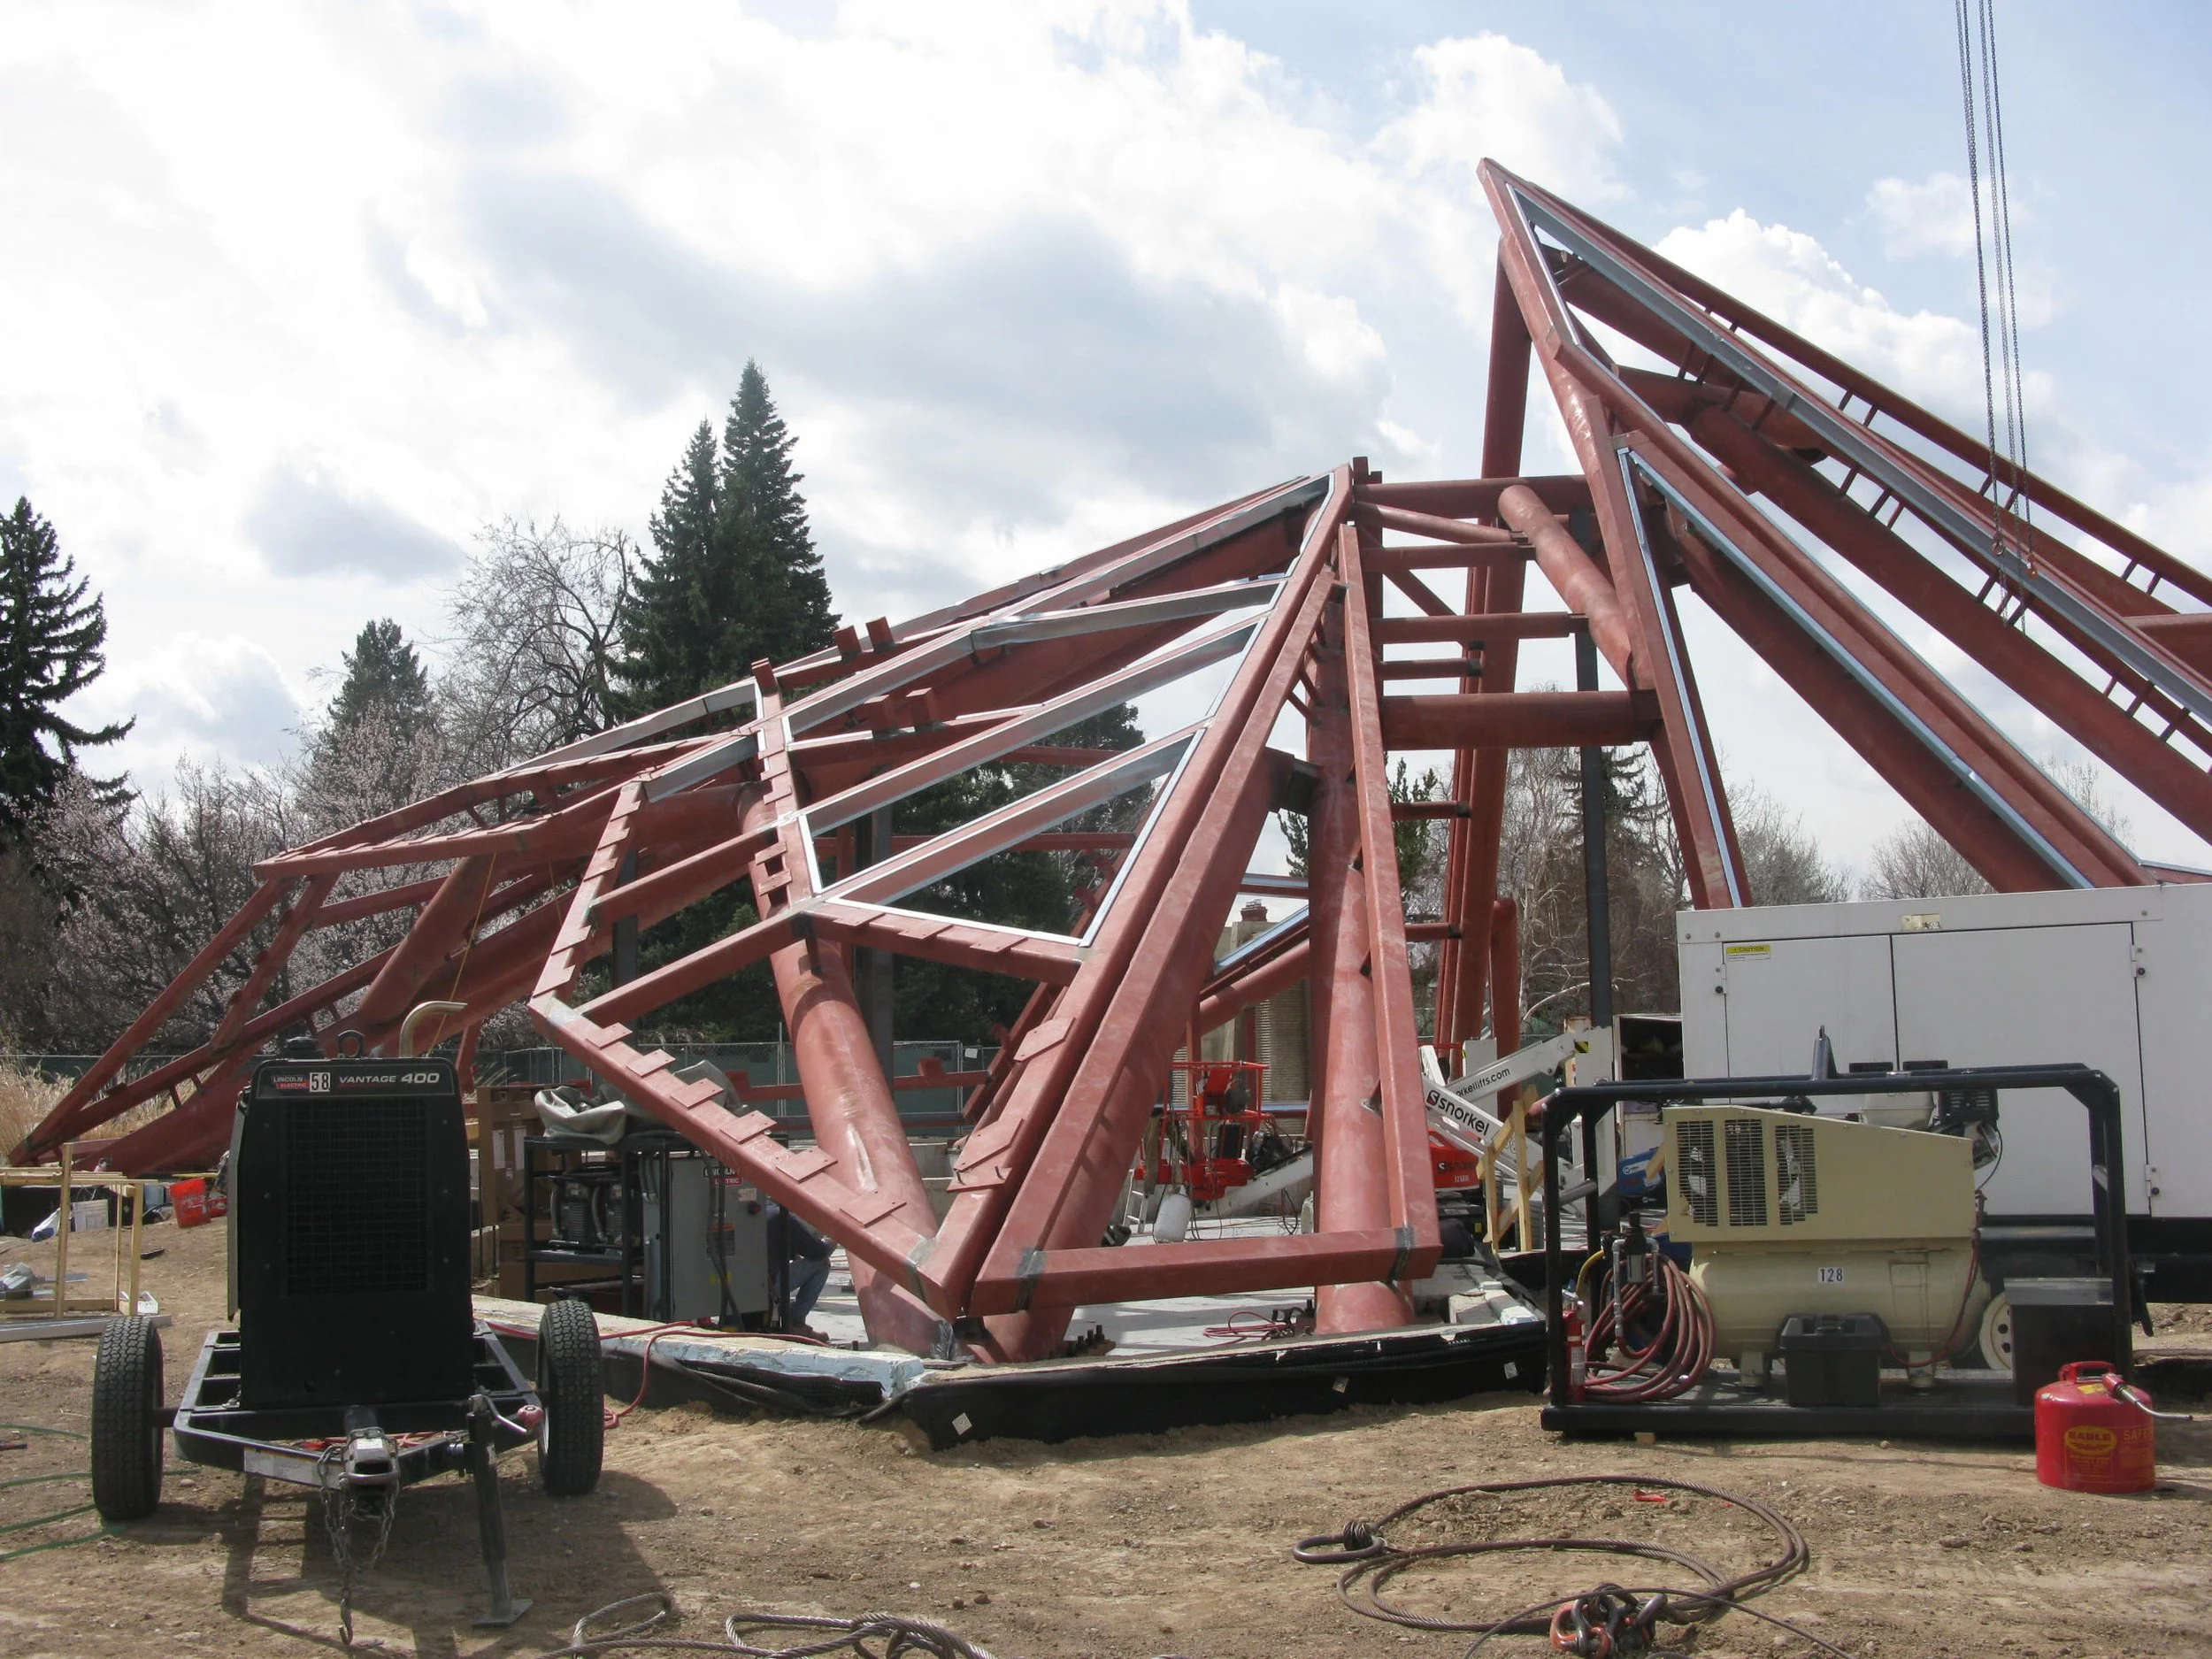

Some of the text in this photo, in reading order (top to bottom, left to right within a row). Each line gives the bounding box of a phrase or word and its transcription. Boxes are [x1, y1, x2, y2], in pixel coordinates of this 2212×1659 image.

[311, 1073, 329, 1091] 58
[339, 1072, 441, 1084] VANTAGE 400
[1455, 1068, 1510, 1097] orkellifts.com
[1437, 1097, 1490, 1136] snorkel
[1819, 1268, 1843, 1282] 128
[2068, 1432, 2111, 1441] EAGLE
